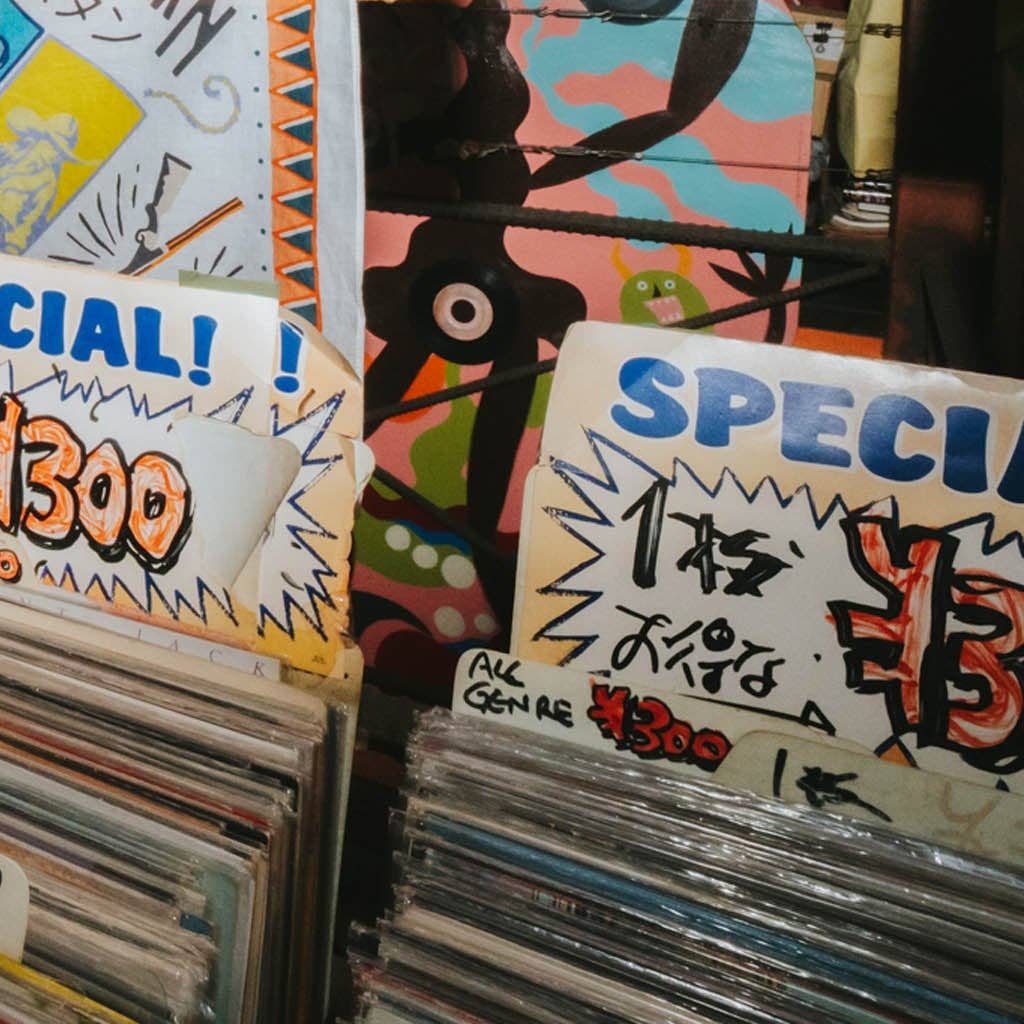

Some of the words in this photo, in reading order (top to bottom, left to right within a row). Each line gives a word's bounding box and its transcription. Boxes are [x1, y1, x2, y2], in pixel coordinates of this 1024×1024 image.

[468, 651, 526, 688] ALL
[463, 680, 575, 728] GENRE
[586, 683, 734, 774] ¥300
